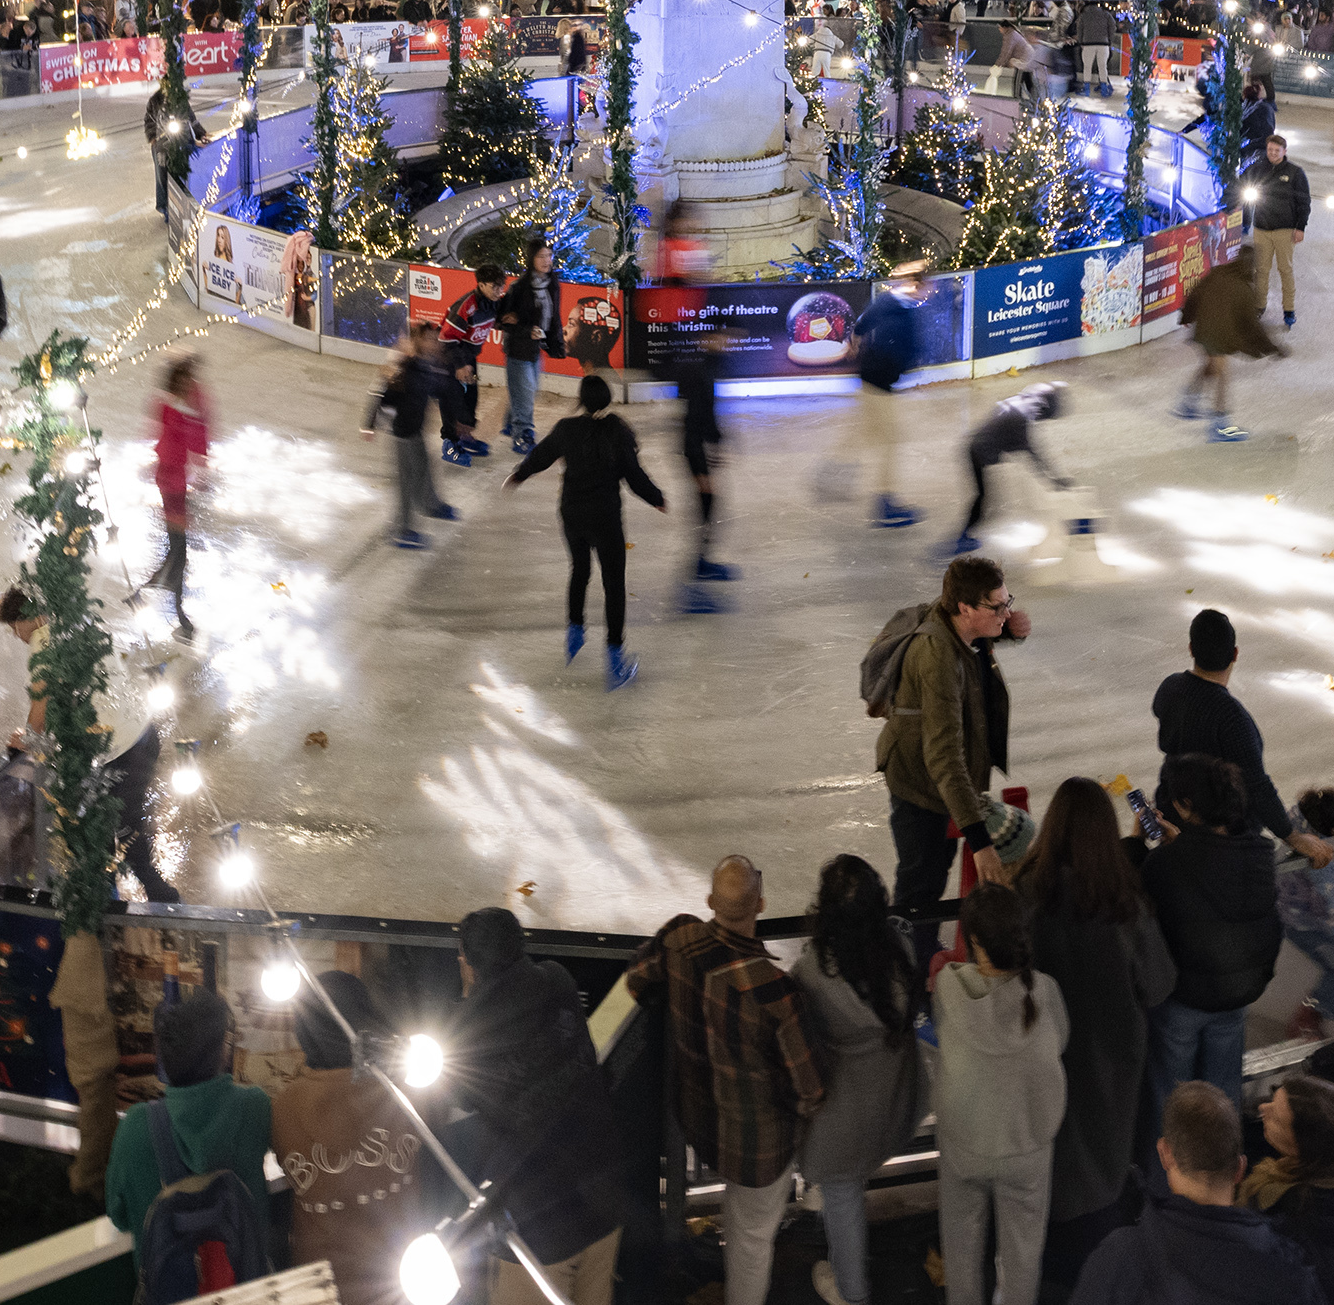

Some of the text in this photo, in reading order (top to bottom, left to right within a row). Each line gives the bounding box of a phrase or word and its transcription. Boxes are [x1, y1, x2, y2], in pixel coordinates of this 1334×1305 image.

[83, 47, 97, 60] ON
[53, 58, 141, 82] CHRISTMAS
[223, 268, 235, 281] ICE
[212, 275, 232, 292] BABY
[1005, 279, 1055, 305] Skate
[677, 306, 696, 317] the
[699, 305, 720, 319] gift
[721, 305, 734, 315] of
[735, 304, 779, 315] theatre
[988, 298, 1070, 323] Leicester Square
[647, 322, 669, 333] this
[989, 330, 1005, 338] SHARE
[1021, 321, 1047, 331] MEMORIES
[1048, 318, 1060, 326] WITH
